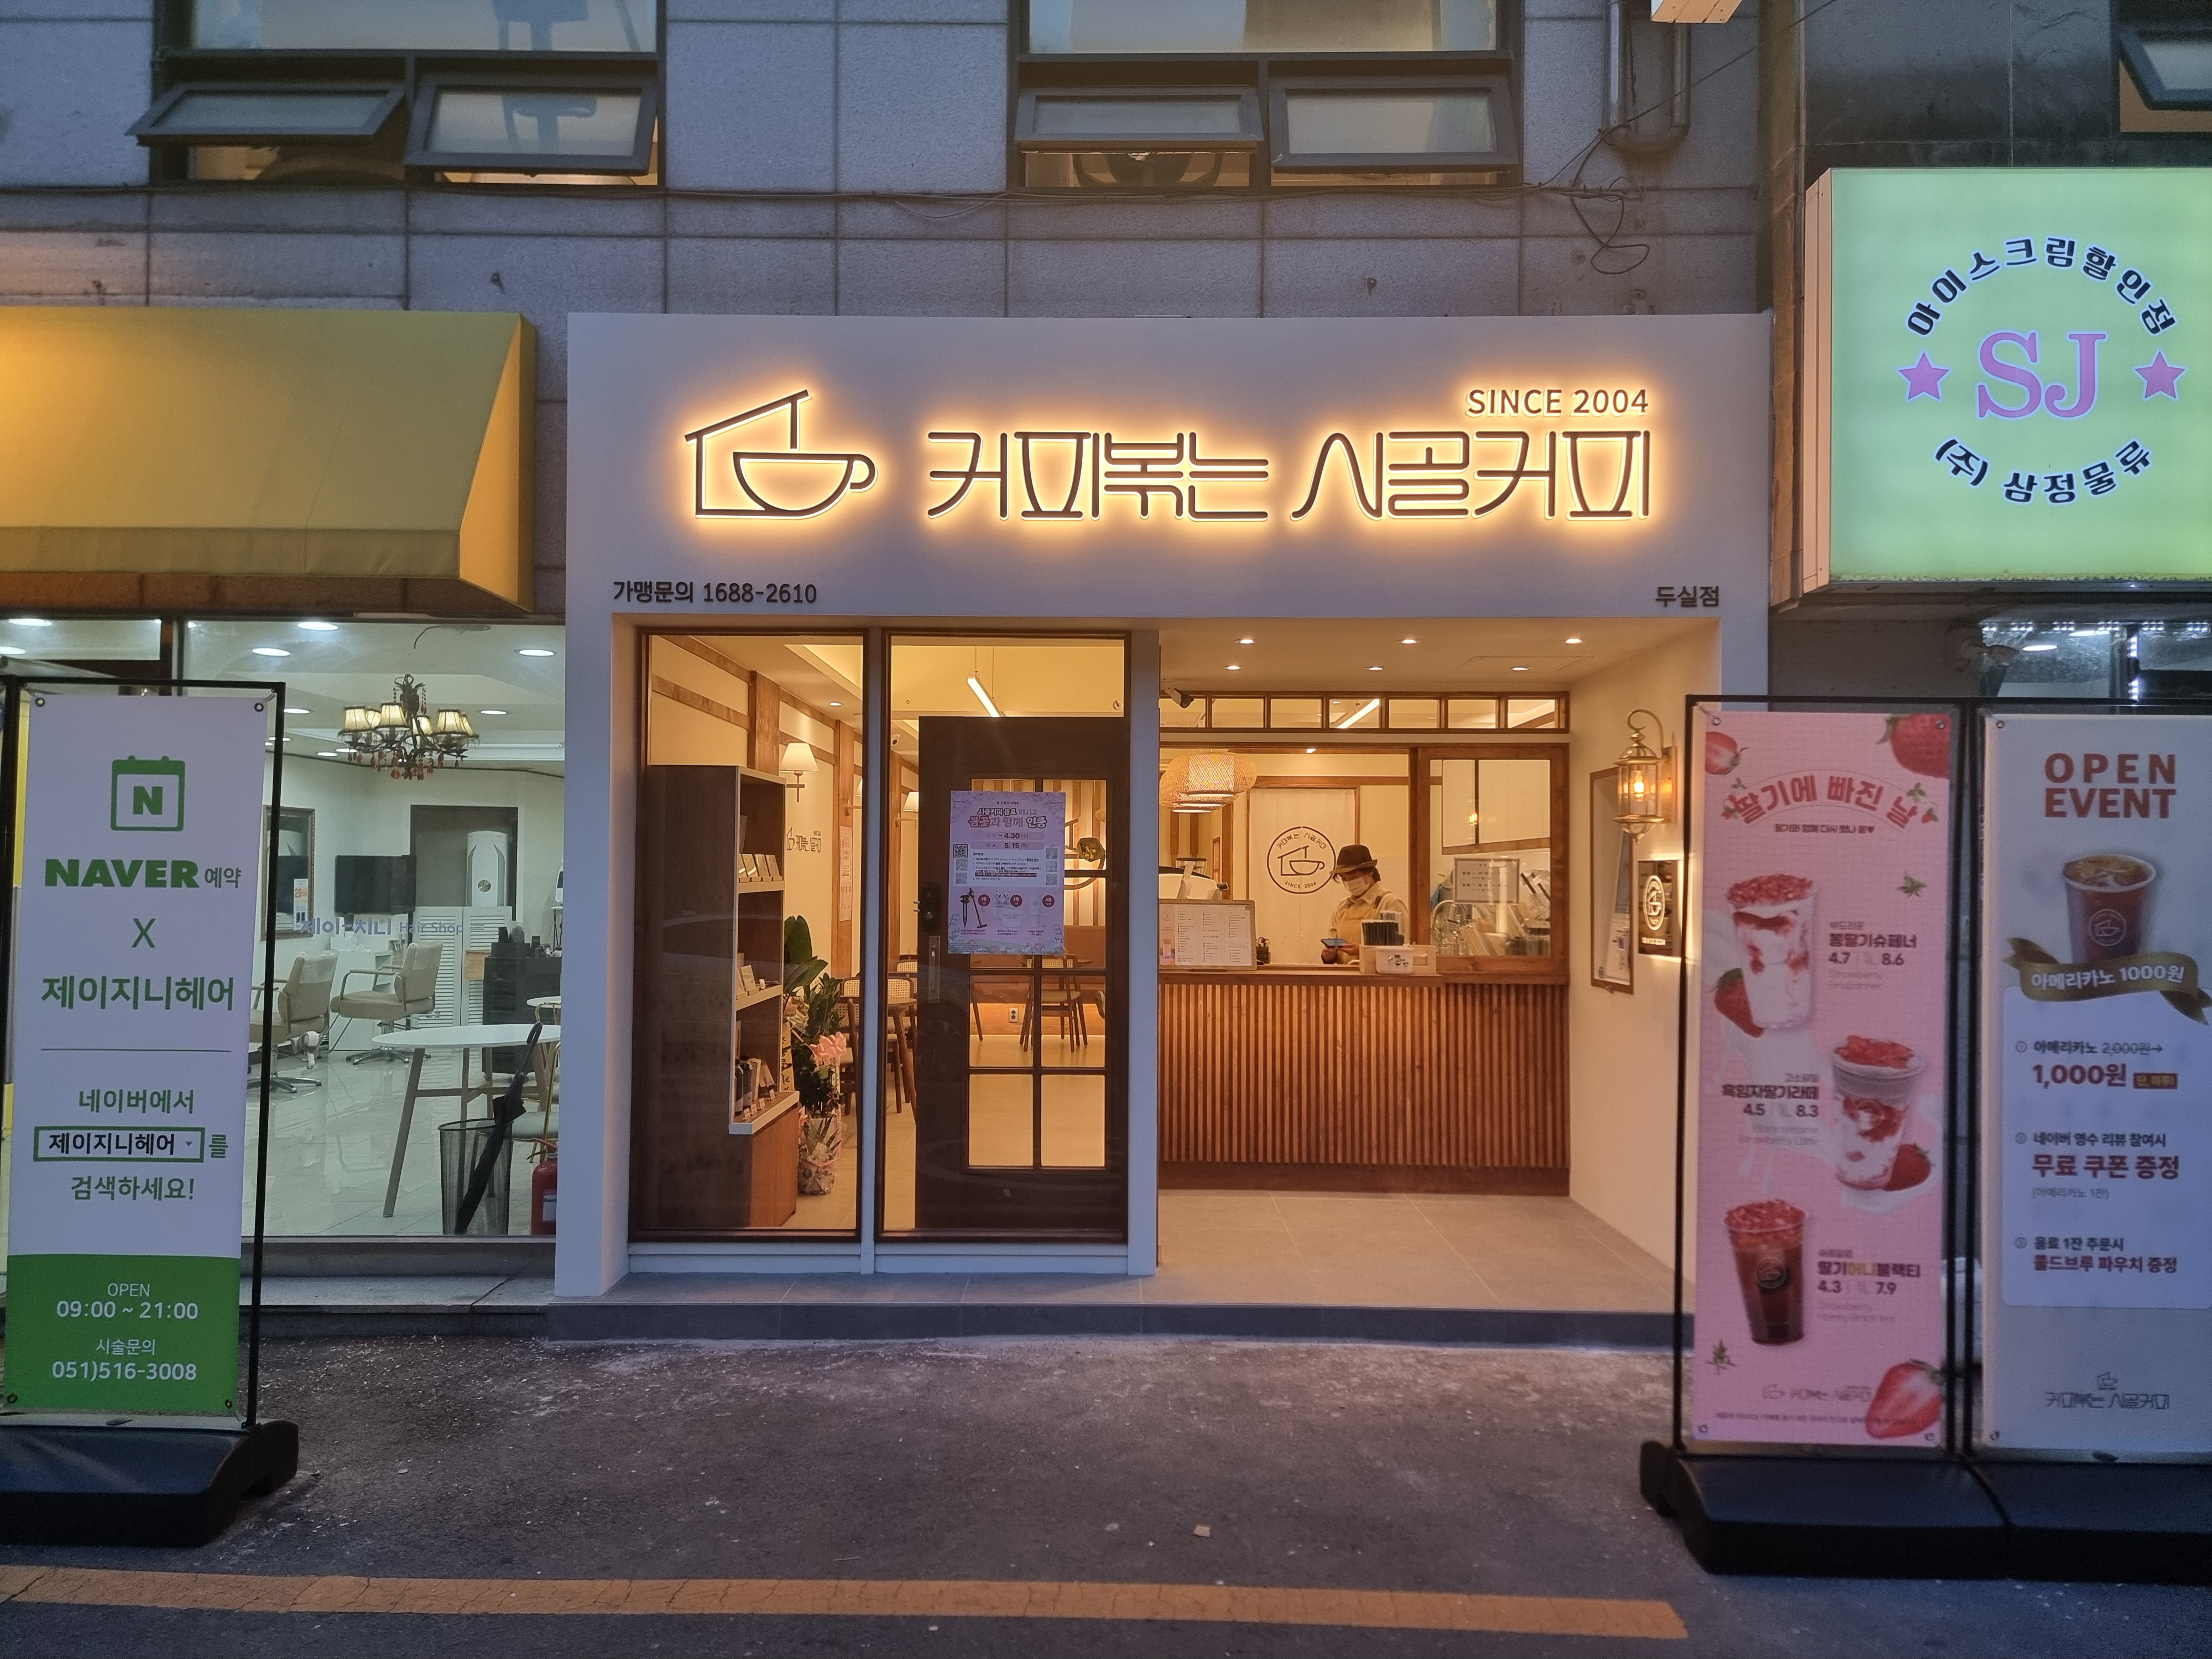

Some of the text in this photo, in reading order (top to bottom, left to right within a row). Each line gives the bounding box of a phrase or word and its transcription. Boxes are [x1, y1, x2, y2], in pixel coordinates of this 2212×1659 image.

[1907, 238, 2176, 336] 아이스크림할인점
[1977, 332, 2106, 419] SJ
[1465, 388, 1649, 416] SINCE 2004
[927, 431, 1651, 520] 커피볶는 시골커피
[1935, 439, 2151, 504] (주) 삼정물류
[613, 581, 817, 604] 가맹문의 1688-2610
[1655, 586, 1720, 608] 두실점
[2044, 753, 2176, 784] OPEN
[133, 786, 163, 815] N
[1733, 775, 1818, 824] 딸기에
[1828, 775, 1884, 812] 빠진
[2044, 787, 2177, 818] EVENT
[1026, 816, 1047, 828] 인증
[45, 859, 242, 889] NAVER 예약
[1284, 880, 1301, 889] SINCE
[132, 918, 156, 948] X
[399, 921, 425, 934] Hair
[430, 921, 464, 936] Shop
[1829, 952, 1850, 964] 4.7
[1881, 953, 1905, 966] 8.6
[2031, 965, 2185, 990] 아메리카노 1000원
[41, 975, 234, 1010] 제이지니헤어
[2033, 1041, 2098, 1055] 아메리카노
[2032, 1063, 2127, 1089] 1,000원
[79, 1089, 194, 1113] 네이버에서
[1744, 1103, 1765, 1117] 4.5
[1796, 1104, 1819, 1118] 8.3
[48, 1132, 229, 1159] 제이지니헤어 를
[2033, 1132, 2071, 1146] 네이버
[2102, 1133, 2127, 1147] 리뷰
[2129, 1133, 2167, 1148] 참여시
[2032, 1154, 2180, 1180] 무료 쿠폰 증정
[71, 1176, 195, 1201] 검색하세요!
[2063, 1237, 2083, 1251] 1잔
[2086, 1238, 2125, 1252] 주문시
[2033, 1254, 2178, 1274] 콜드브루 파우치 증정
[107, 1283, 150, 1297] OPEN
[1818, 1280, 1842, 1293] 4.3
[1876, 1281, 1897, 1295] 7.9
[56, 1301, 116, 1318] 09:00
[139, 1302, 199, 1319] 21:00
[96, 1338, 156, 1356] 시술문의
[52, 1360, 197, 1381] 051)516-3008
